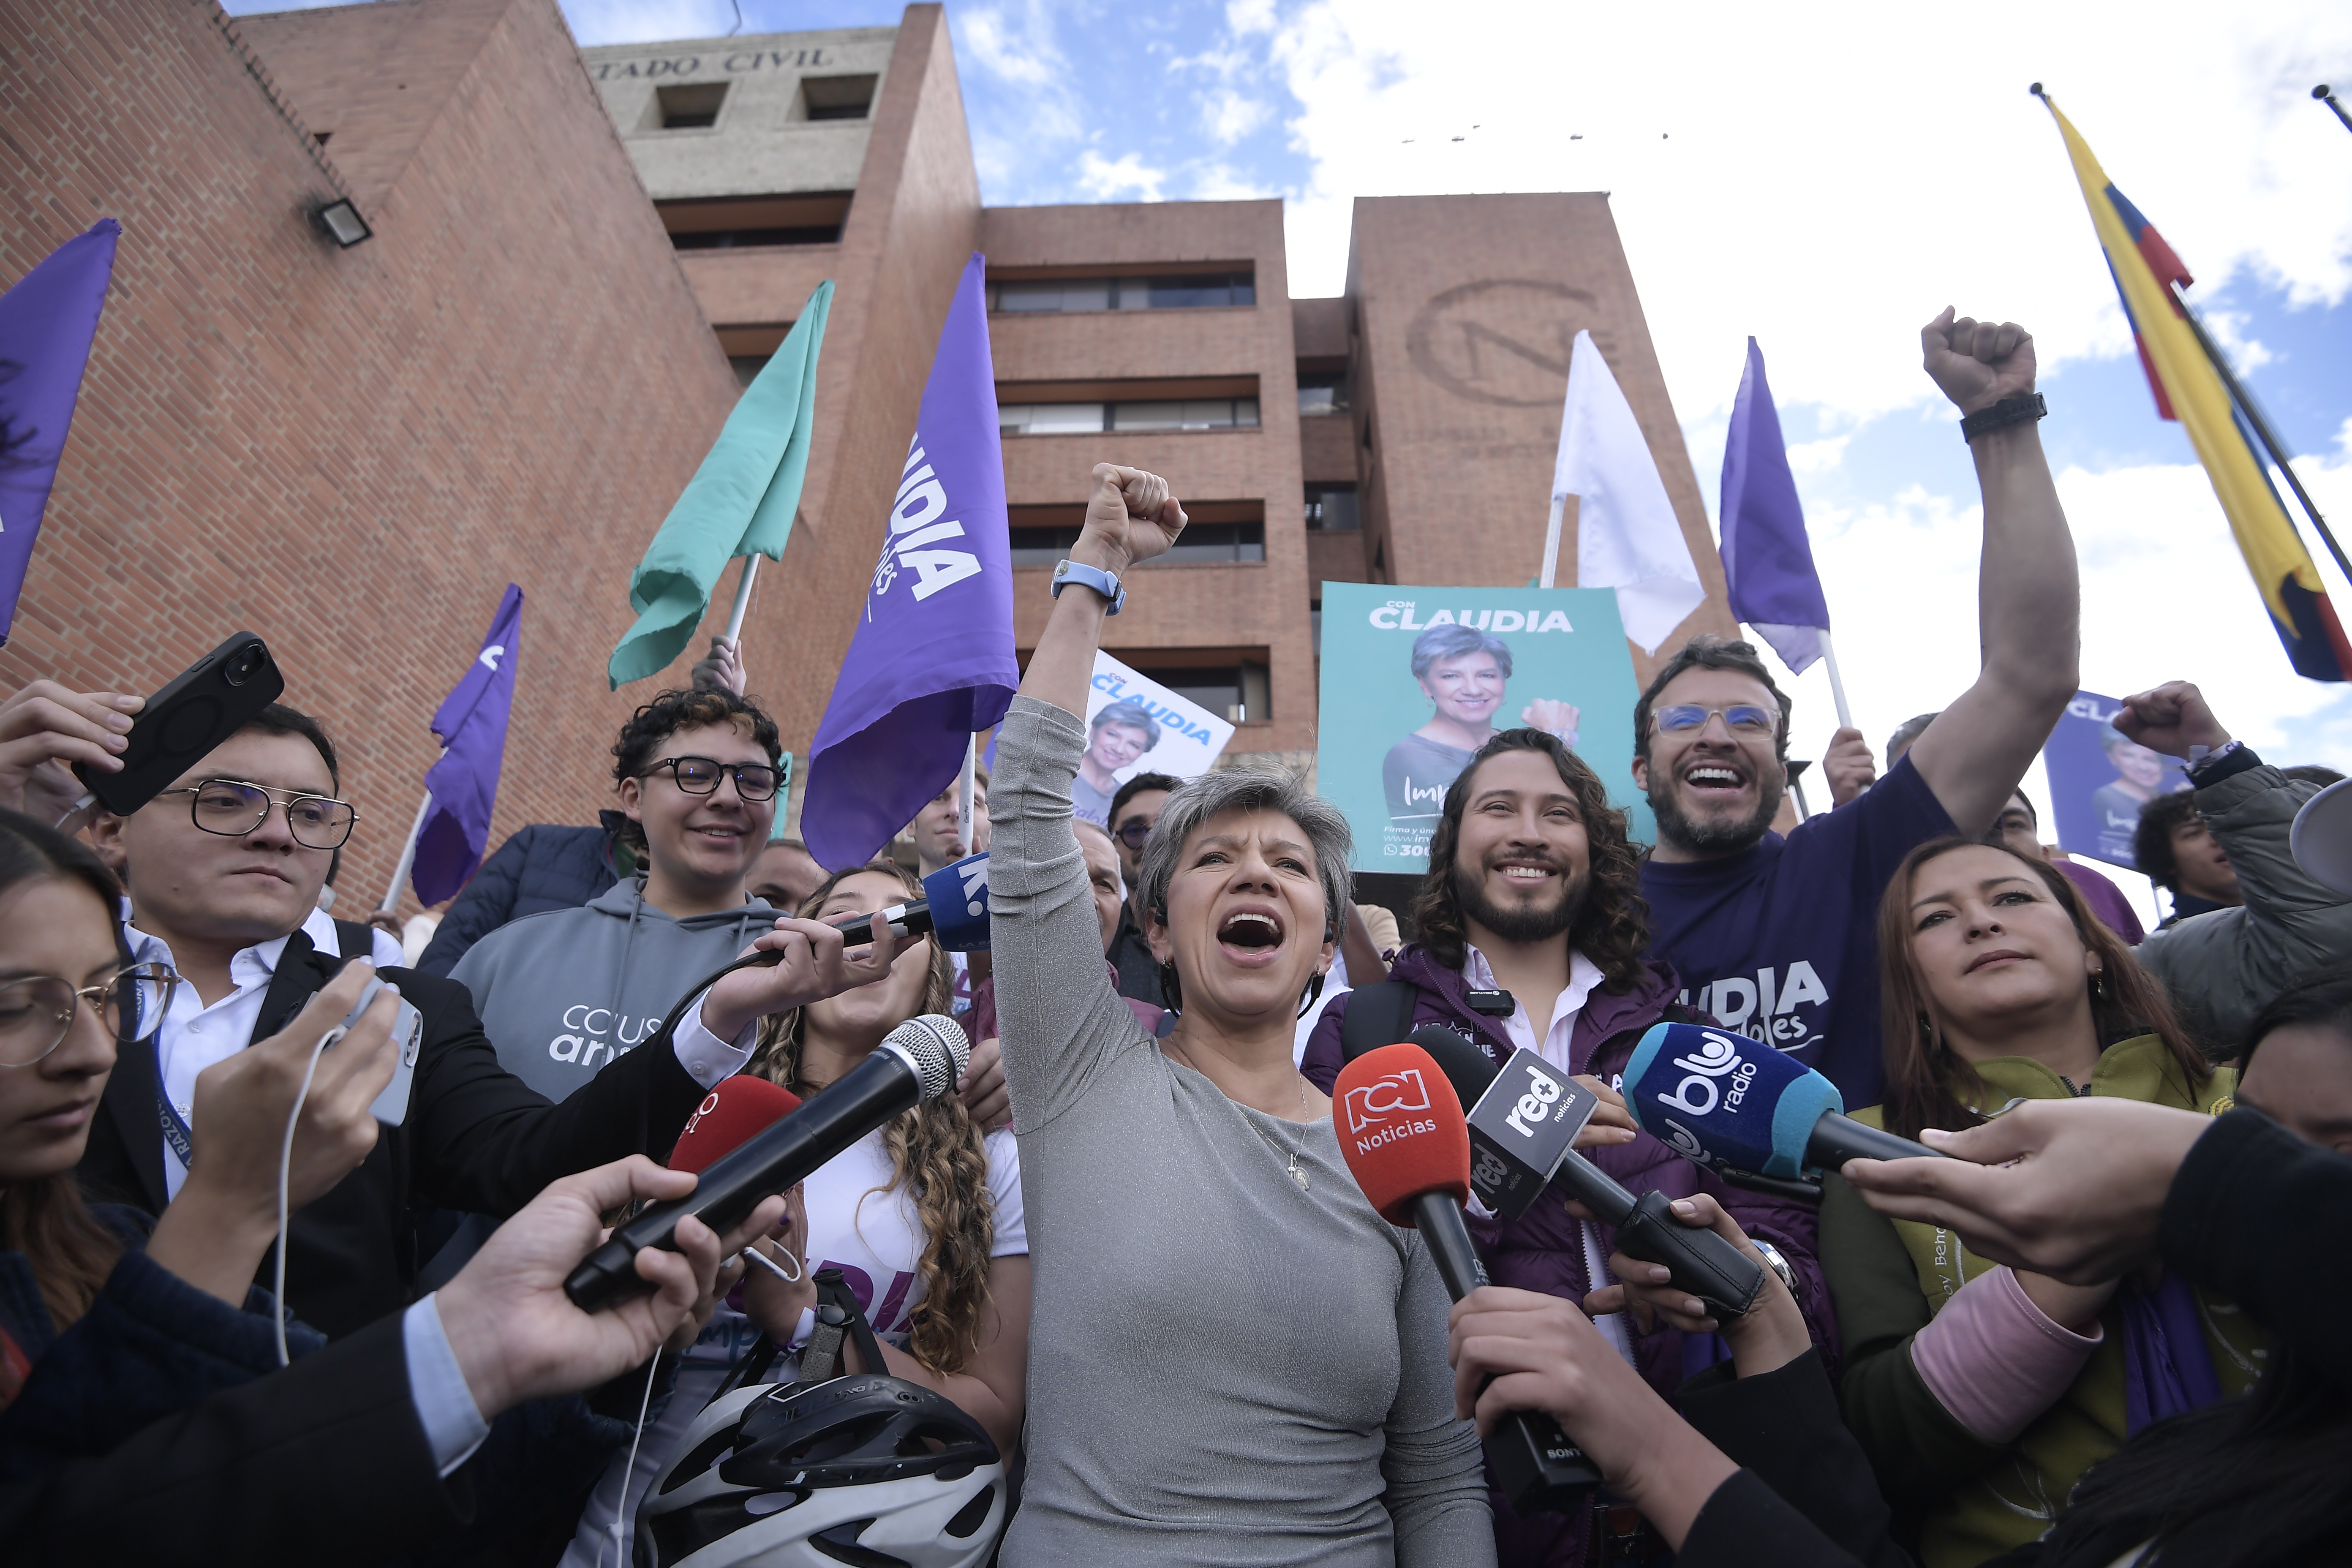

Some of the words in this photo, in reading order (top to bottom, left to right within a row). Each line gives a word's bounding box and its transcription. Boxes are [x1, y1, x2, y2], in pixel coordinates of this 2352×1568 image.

[724, 49, 834, 74] CIVIL
[1369, 607, 1573, 632] CLAUDIA
[1109, 672, 1127, 684] CON
[1091, 674, 1211, 746] CLAUDIA
[1384, 834, 1431, 842] www.im
[1657, 1032, 1742, 1116] blu
[1723, 1063, 1757, 1113] radio
[1554, 1093, 1576, 1123] noticias
[1356, 1119, 1436, 1156] Noticias
[1508, 1173, 1522, 1191] noticias
[1546, 1448, 1581, 1459] SONY
